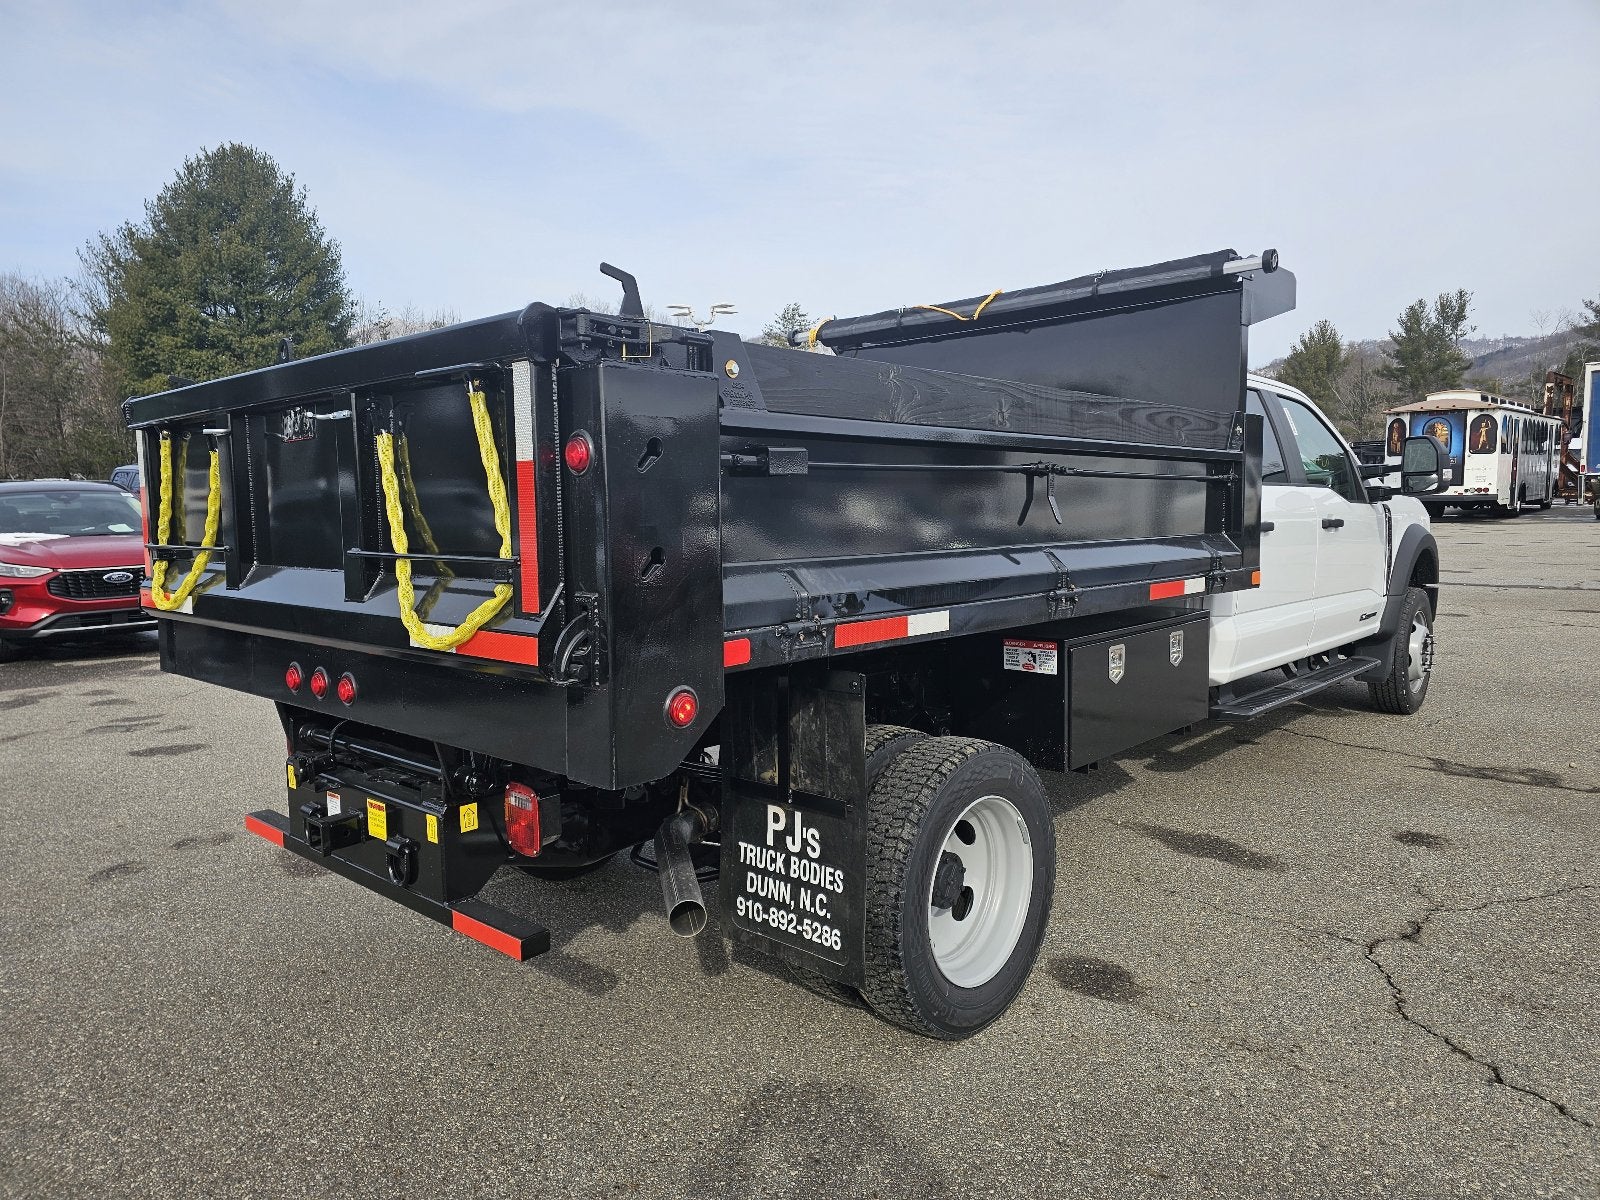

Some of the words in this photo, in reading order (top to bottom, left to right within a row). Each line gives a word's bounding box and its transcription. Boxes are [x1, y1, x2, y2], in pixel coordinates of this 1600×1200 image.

[738, 841, 786, 875] TRUCK
[789, 855, 844, 894] BODIES
[746, 871, 795, 910] DUNN,
[799, 887, 831, 919] N.C.
[736, 896, 842, 951] 910-892-5286
